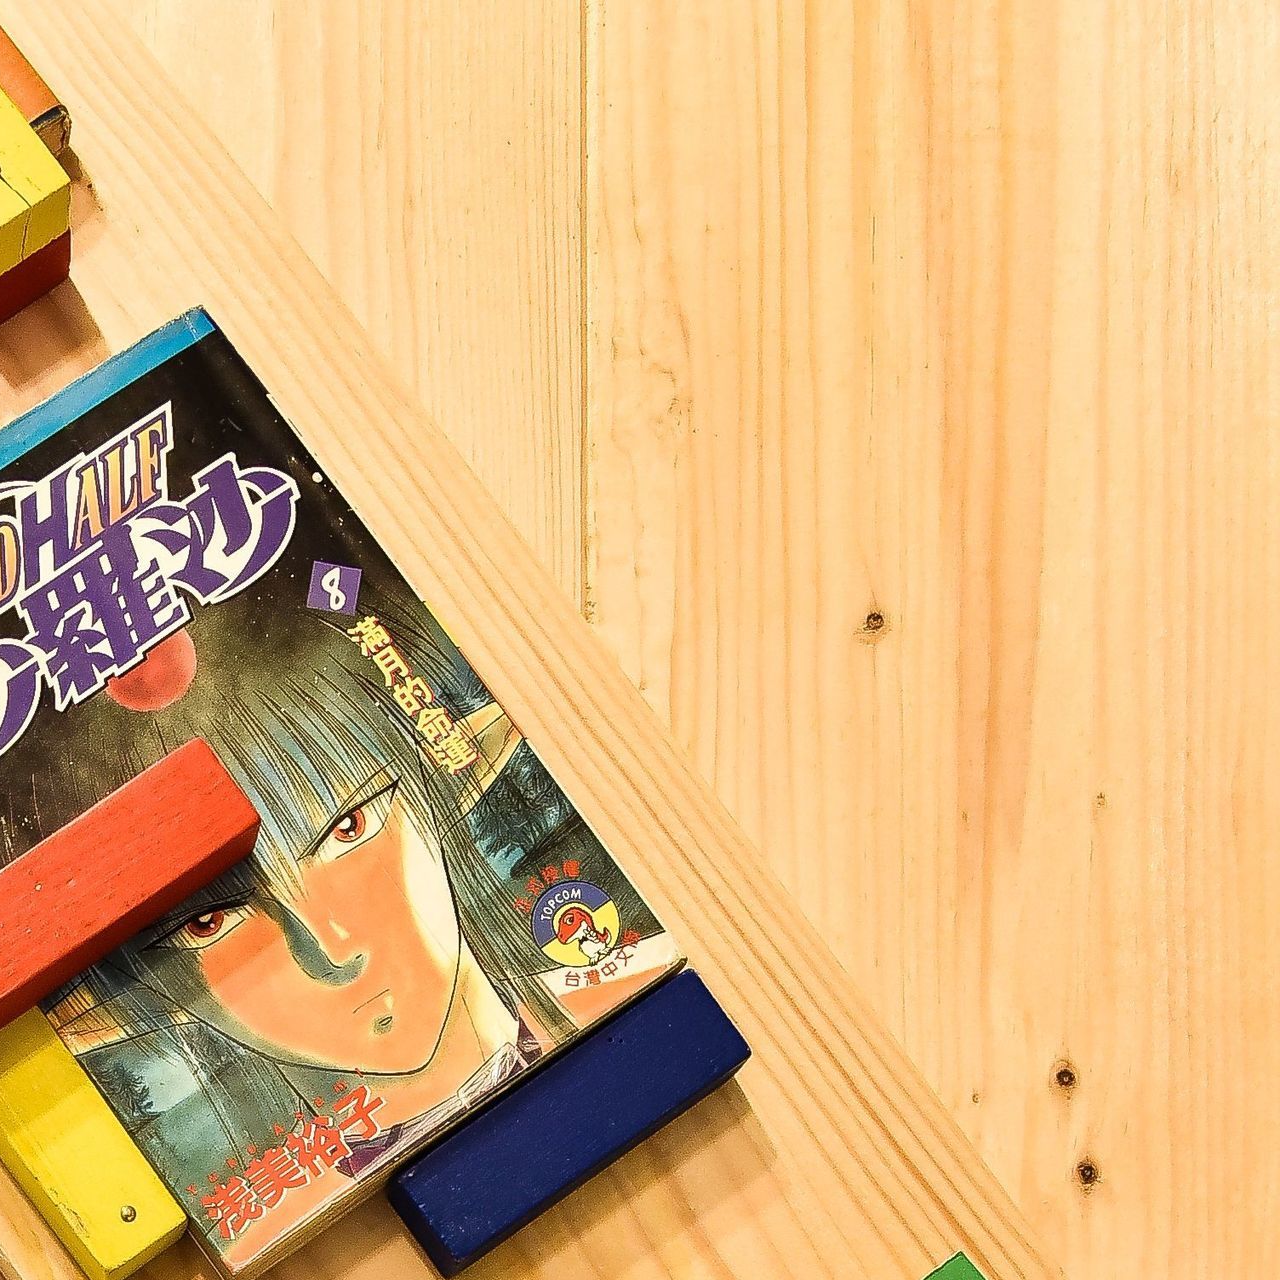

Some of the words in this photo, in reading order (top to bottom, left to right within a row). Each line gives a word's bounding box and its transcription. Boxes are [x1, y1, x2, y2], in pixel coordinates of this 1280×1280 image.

[18, 402, 172, 592] HALF
[321, 567, 346, 611] 8
[540, 888, 582, 921] TOPCOM
[565, 928, 641, 987] 台灣中文版
